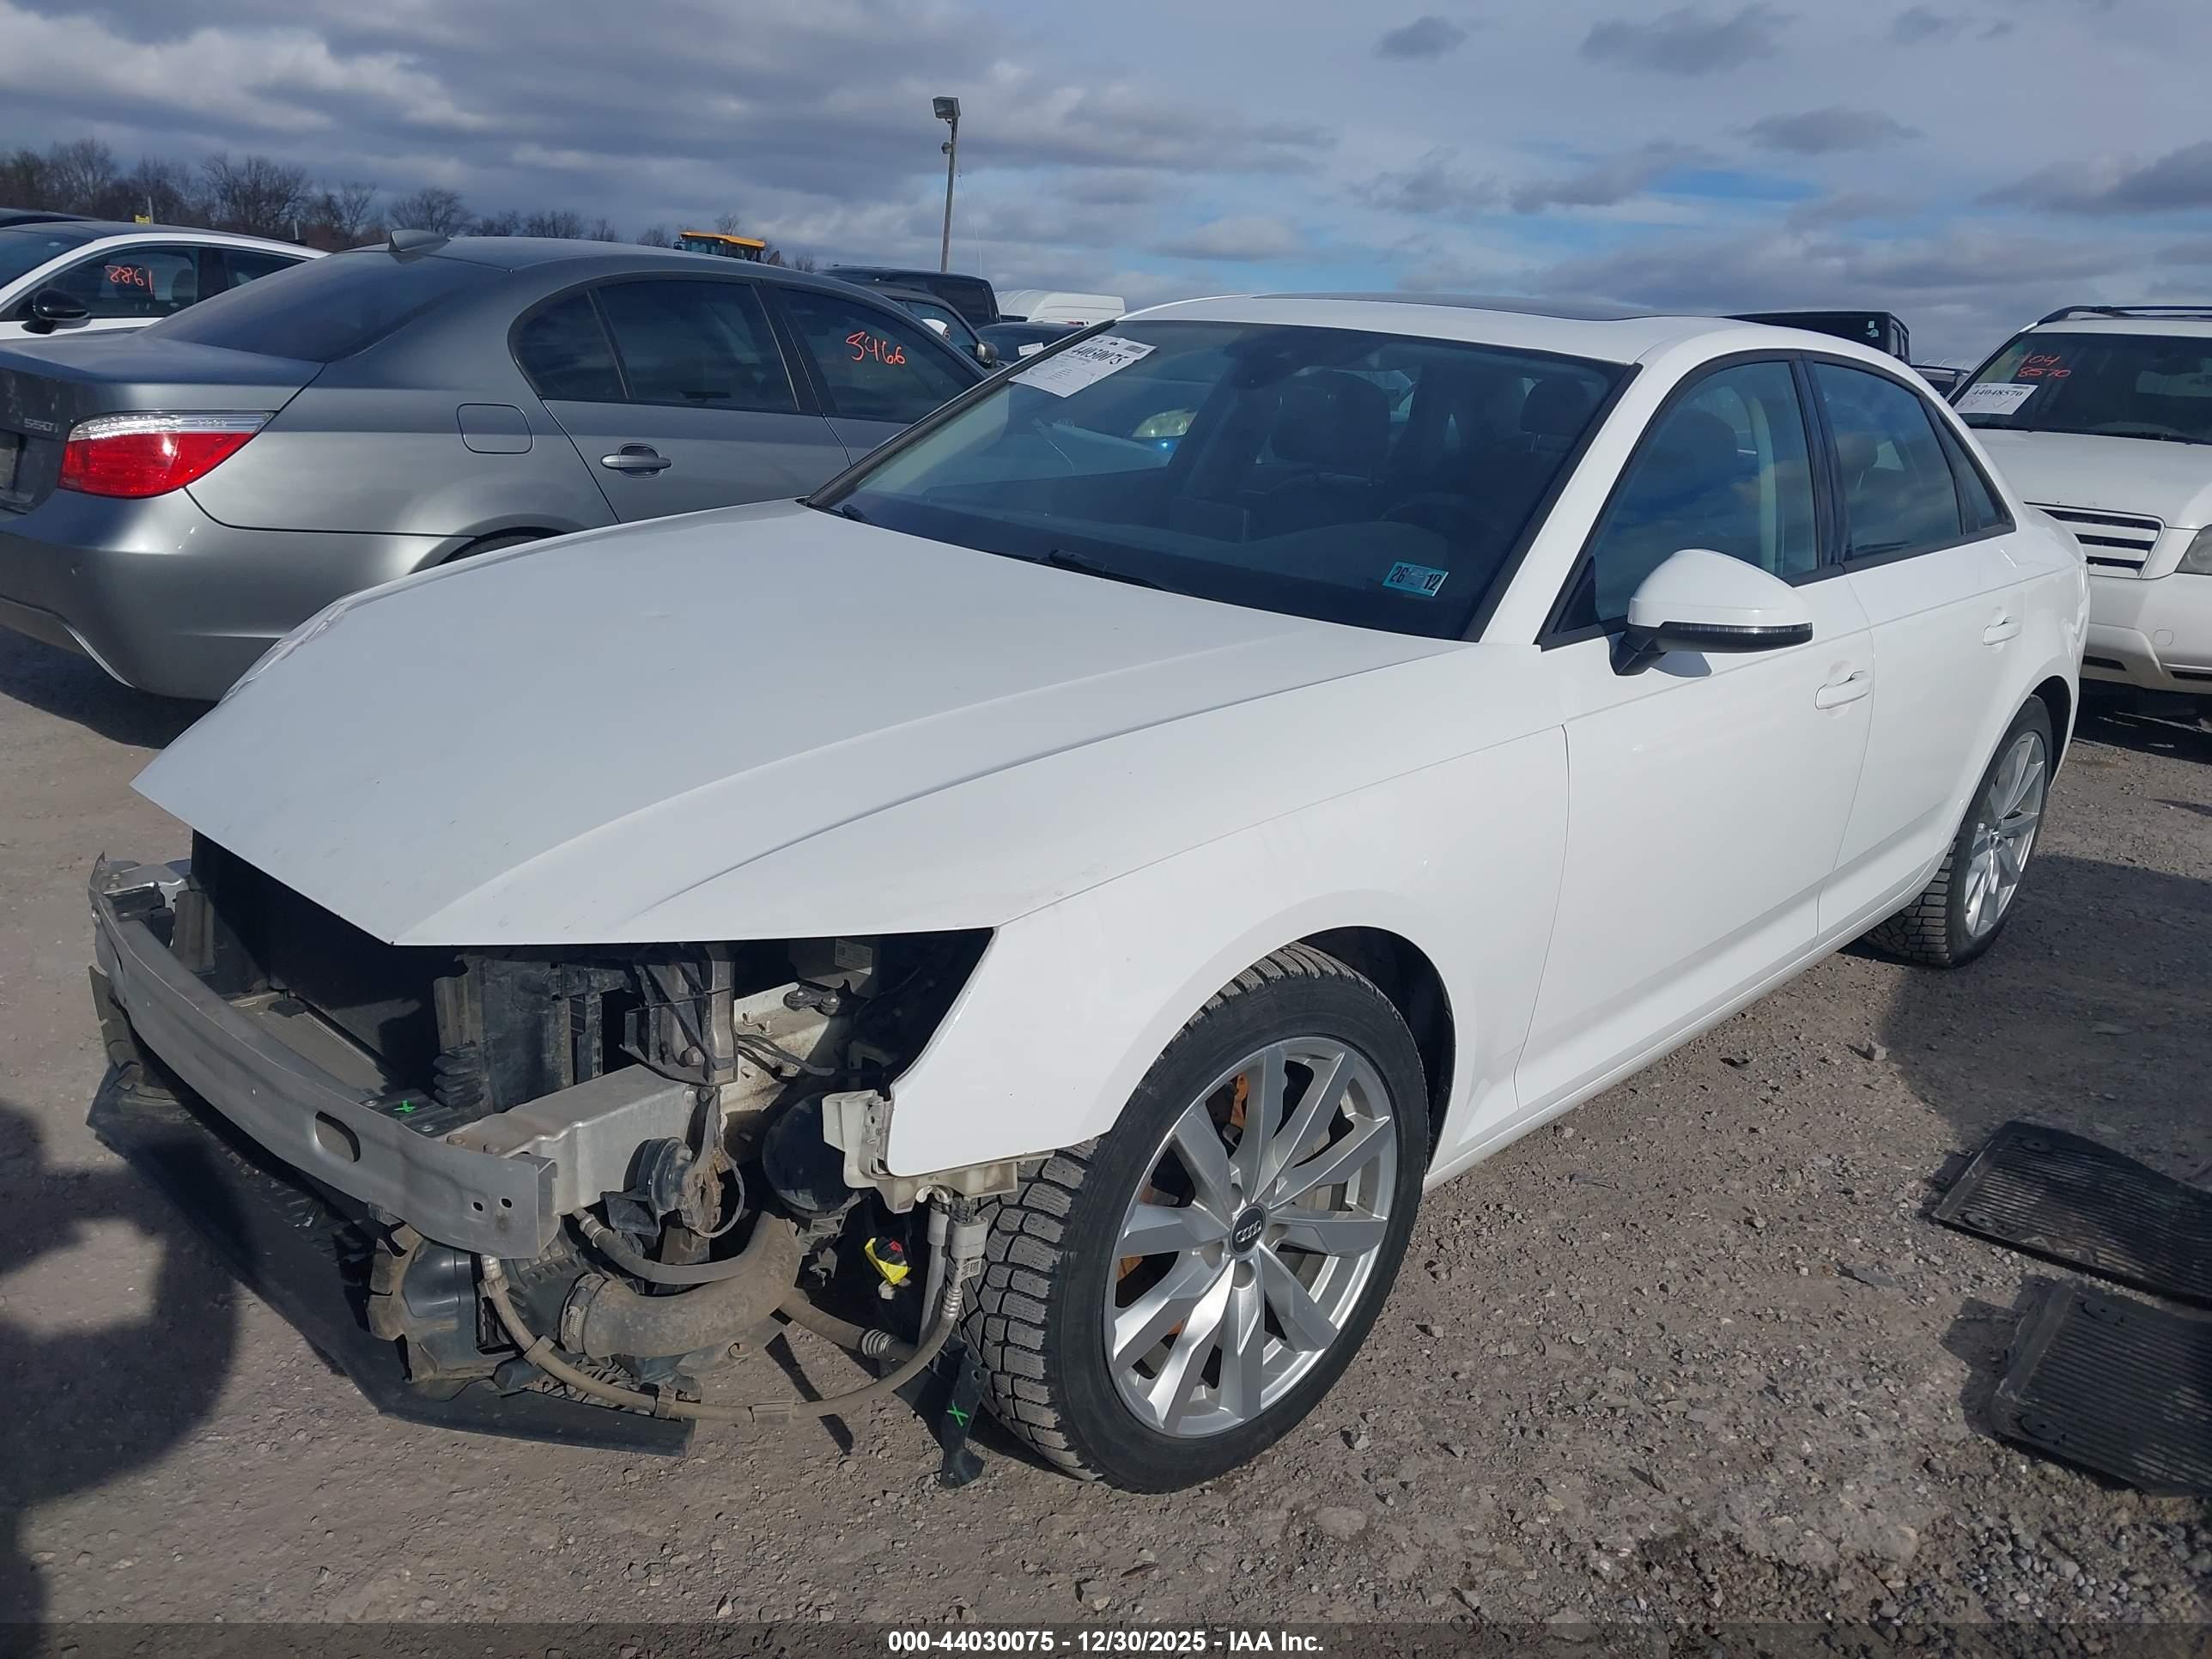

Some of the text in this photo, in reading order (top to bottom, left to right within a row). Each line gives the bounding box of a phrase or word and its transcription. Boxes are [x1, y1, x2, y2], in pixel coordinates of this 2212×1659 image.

[104, 264, 153, 294] 8861
[2018, 367, 2072, 378] 8570
[1389, 566, 1443, 592] 26 12
